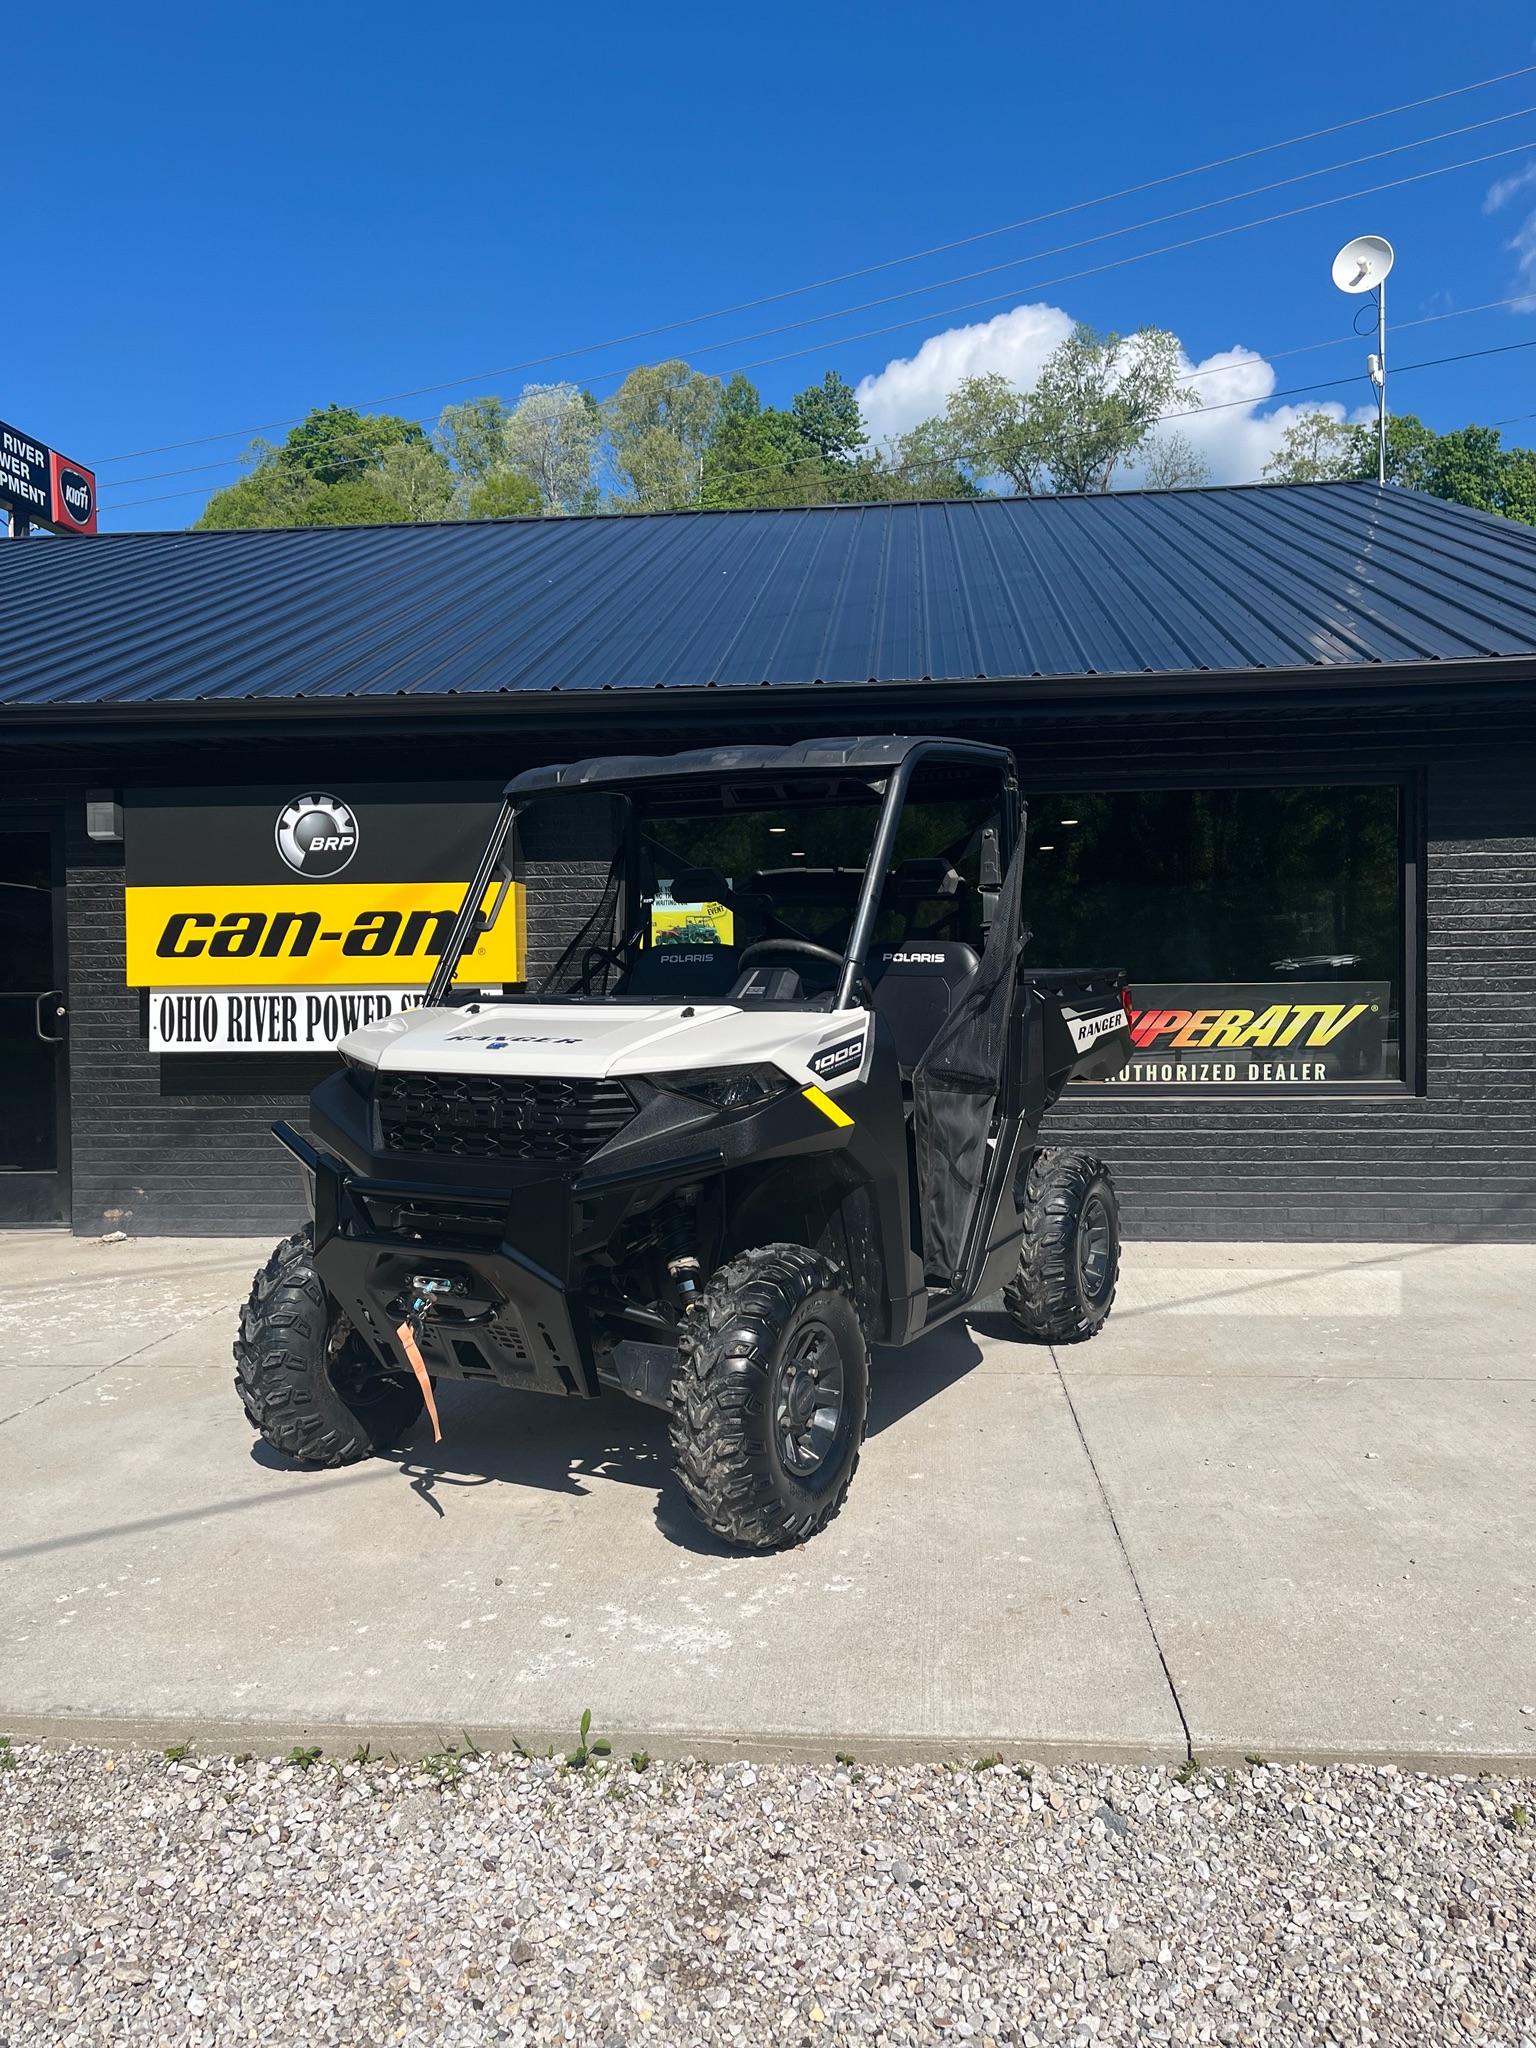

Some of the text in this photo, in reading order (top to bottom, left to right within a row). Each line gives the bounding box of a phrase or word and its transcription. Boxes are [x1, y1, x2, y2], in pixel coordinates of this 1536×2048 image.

[4, 432, 45, 468] RIVER
[66, 485, 88, 510] KIOTI
[309, 836, 354, 851] BRP
[707, 906, 724, 916] EVENT
[661, 954, 714, 963] POLARIS
[883, 953, 945, 963] POLARIS
[160, 995, 218, 1042] OHIO
[227, 995, 297, 1042] RIVER
[1078, 1013, 1122, 1041] RANGER
[1130, 1004, 1369, 1048] UPERATV
[445, 1036, 583, 1044] RANGER
[815, 1042, 862, 1071] 1000
[1105, 1063, 1326, 1082] UTHORIZED DEALER
[402, 1100, 561, 1132] POLARIS
